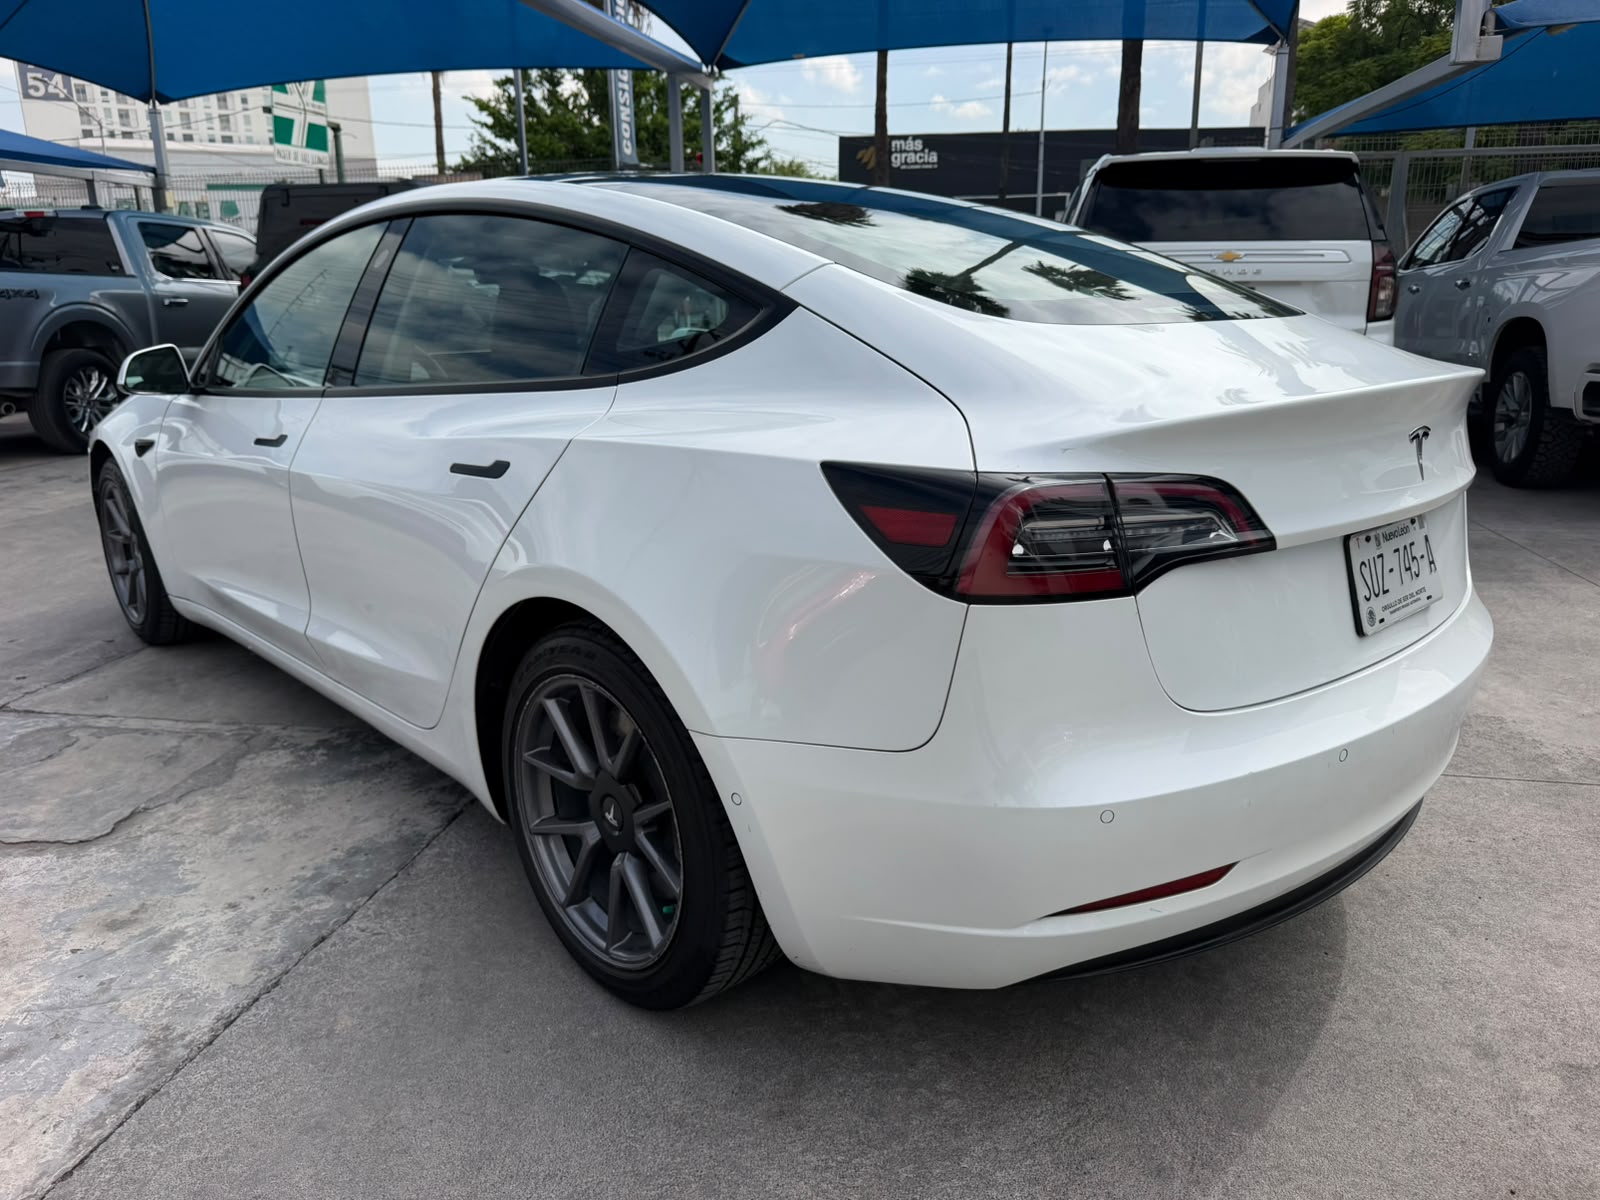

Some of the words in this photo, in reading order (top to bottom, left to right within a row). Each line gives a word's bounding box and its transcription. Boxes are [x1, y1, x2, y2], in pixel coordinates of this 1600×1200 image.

[27, 72, 68, 98] 54
[891, 136, 923, 152] más
[891, 148, 938, 168] gracia
[1360, 534, 1437, 602] SUZ-745-A
